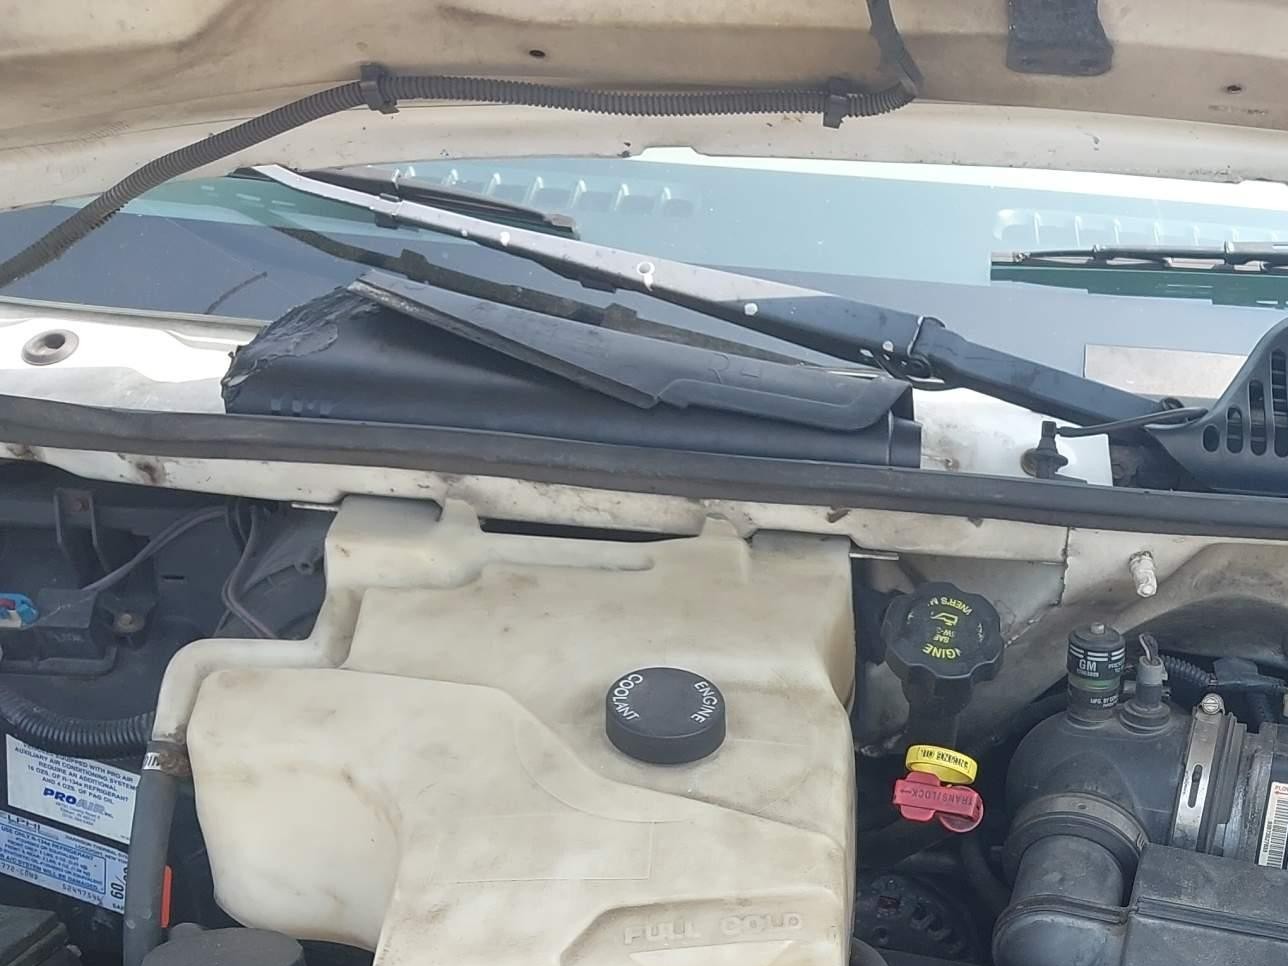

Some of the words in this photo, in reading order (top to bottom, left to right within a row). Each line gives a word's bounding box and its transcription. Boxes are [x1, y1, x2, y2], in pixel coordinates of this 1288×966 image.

[940, 597, 973, 615] NER'S
[922, 643, 961, 659] GINE
[1079, 659, 1097, 671] GM
[612, 673, 644, 720] COOLANT
[691, 680, 718, 723] ENGINE
